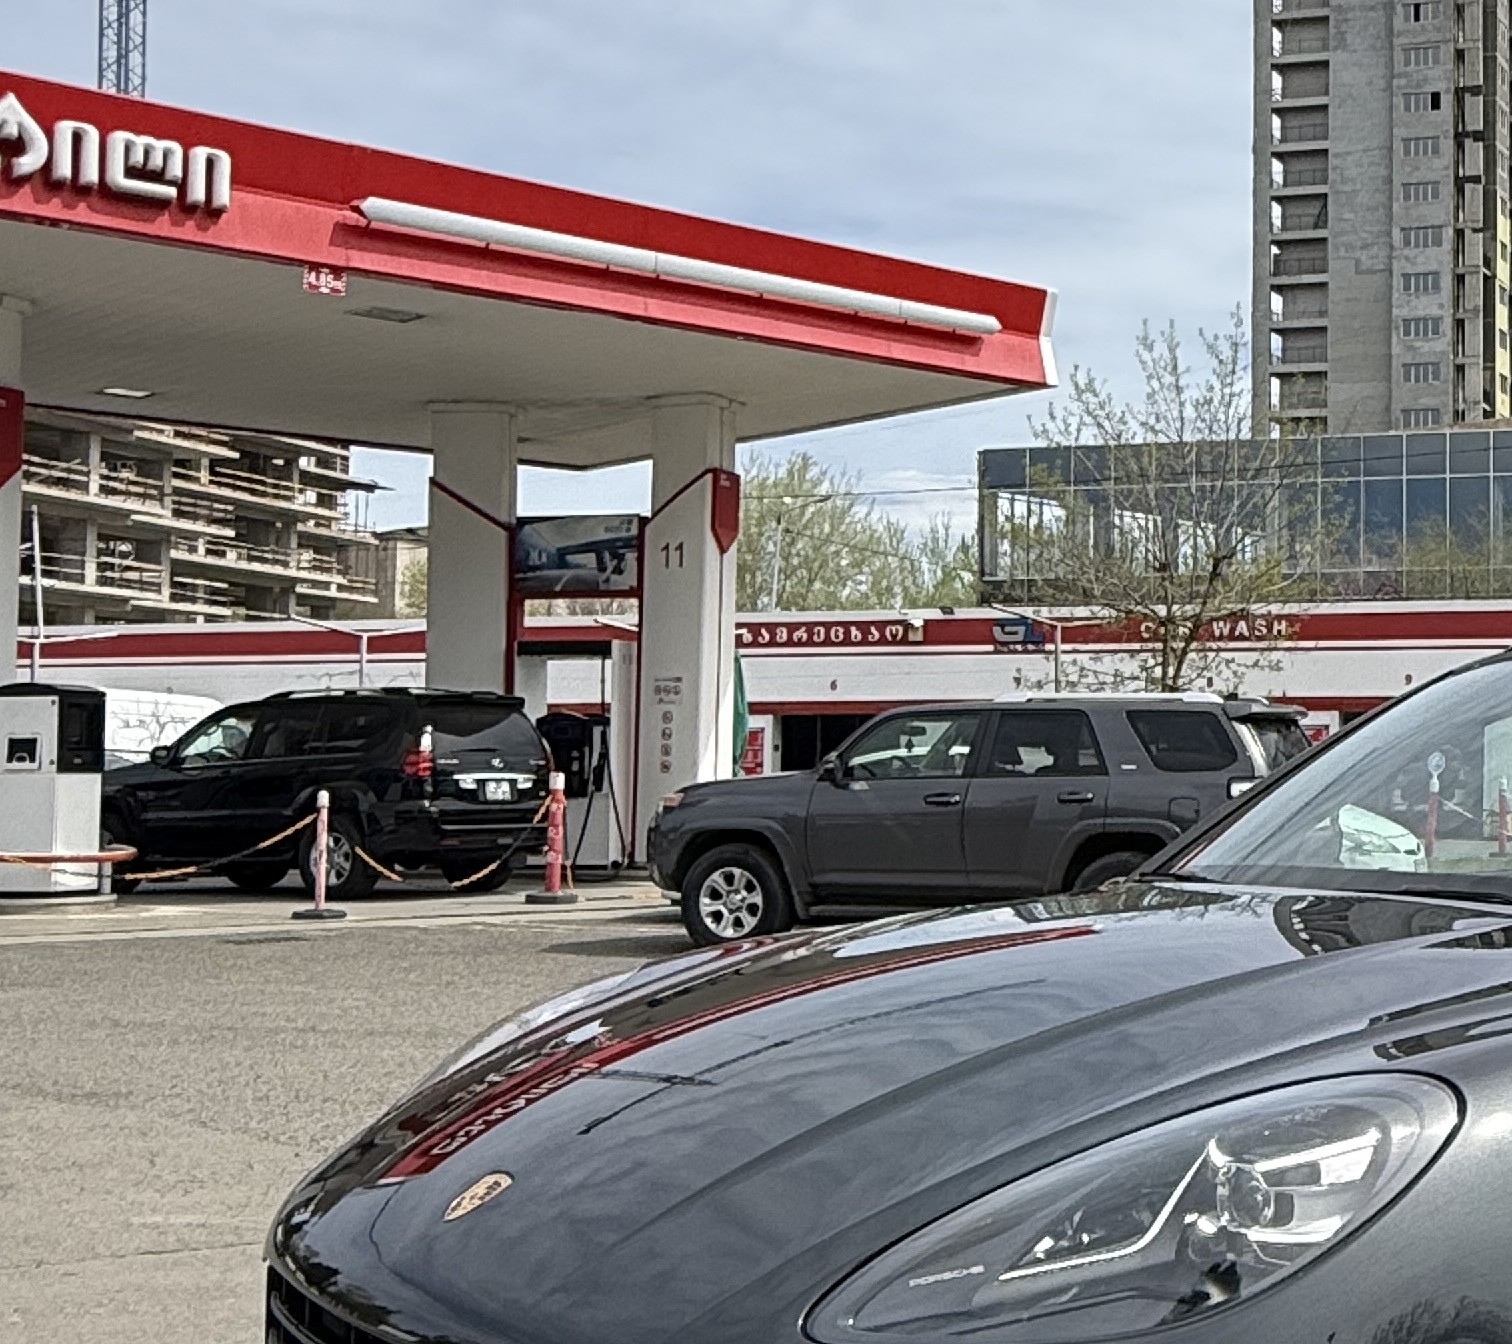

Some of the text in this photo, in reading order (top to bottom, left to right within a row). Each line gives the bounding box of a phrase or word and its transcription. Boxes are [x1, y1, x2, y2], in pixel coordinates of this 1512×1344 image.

[660, 540, 684, 569] 11
[1212, 619, 1287, 638] WASH
[830, 679, 838, 691] 6
[1404, 674, 1413, 685] 9
